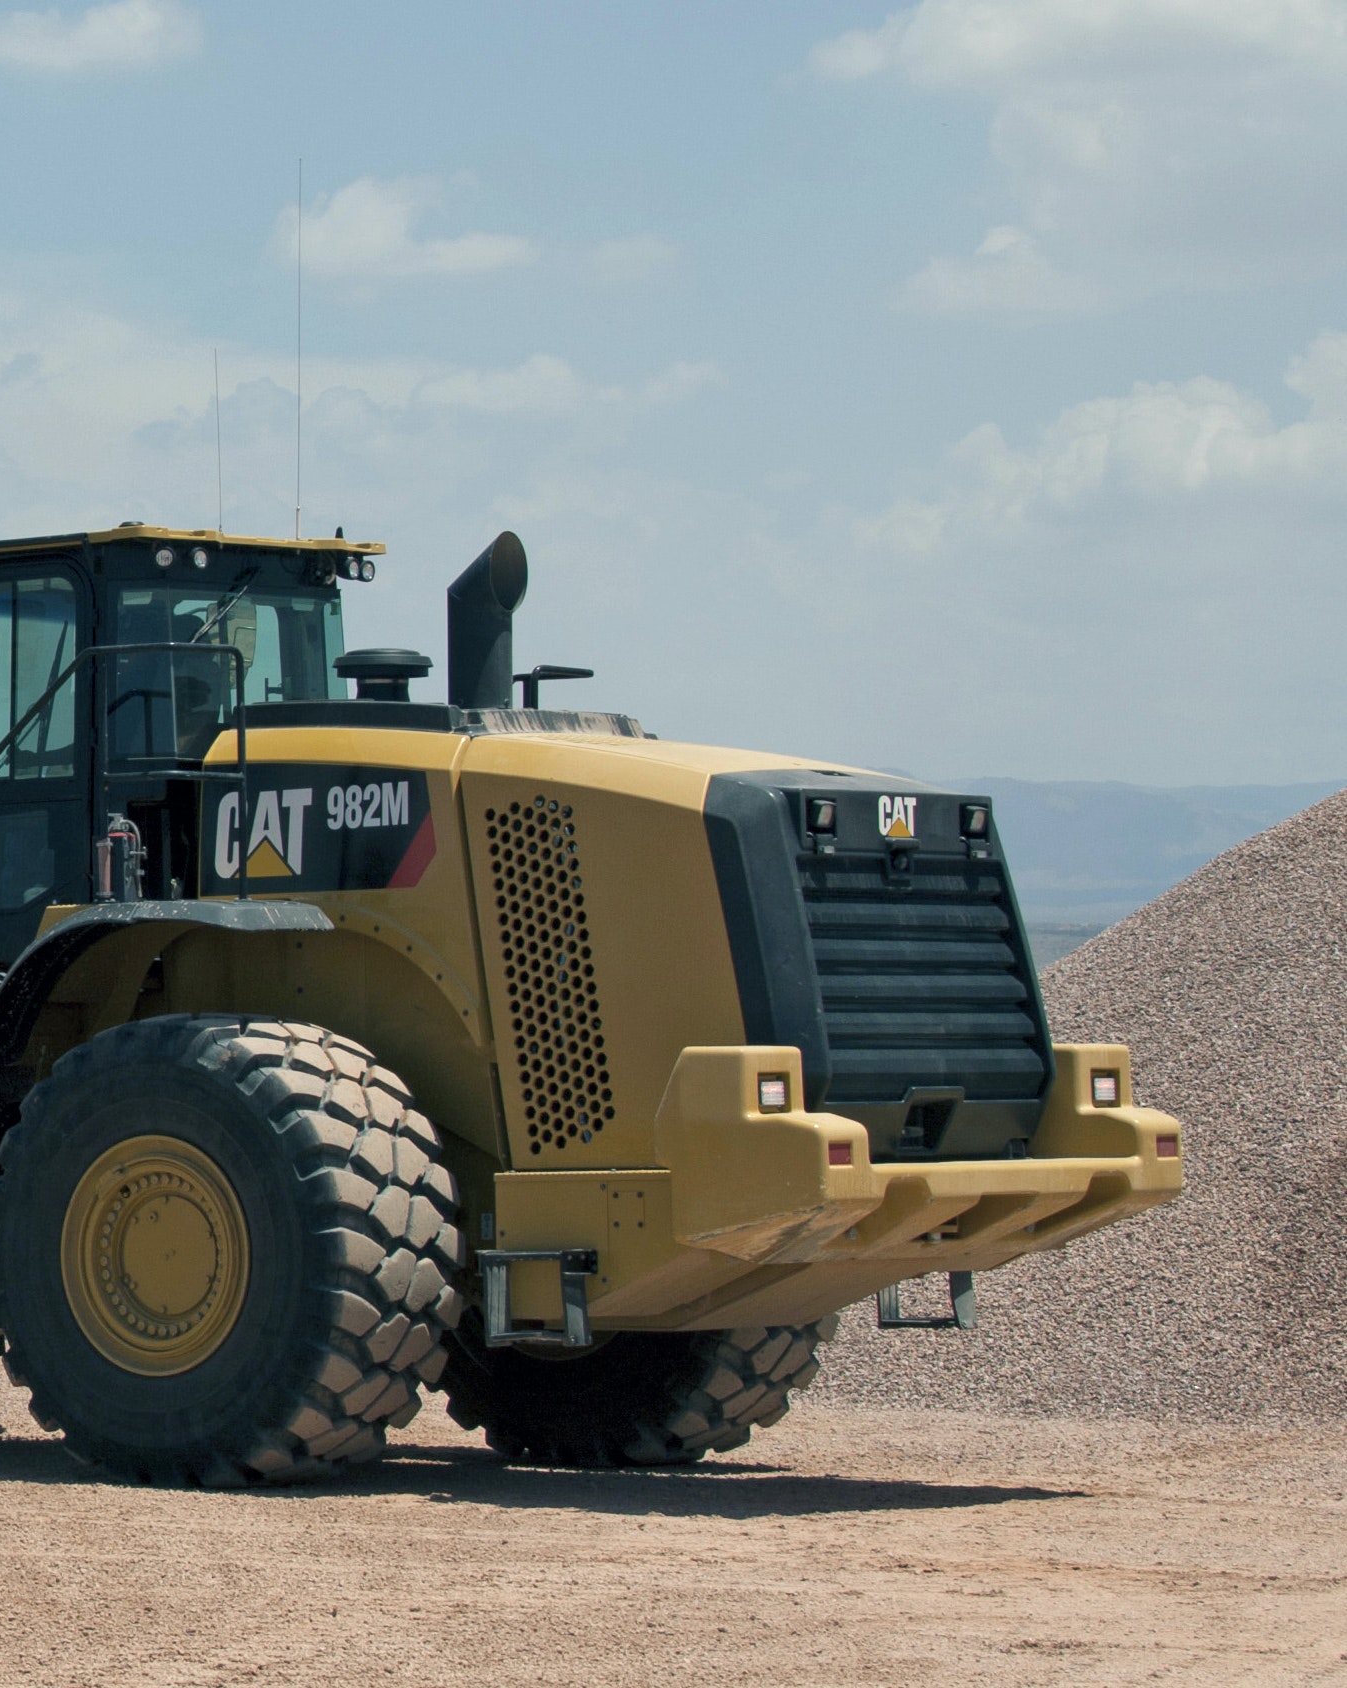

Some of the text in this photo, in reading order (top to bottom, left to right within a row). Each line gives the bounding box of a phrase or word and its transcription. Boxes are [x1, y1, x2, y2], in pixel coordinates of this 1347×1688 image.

[215, 781, 408, 878] CAT 982M
[878, 795, 917, 837] CAT
